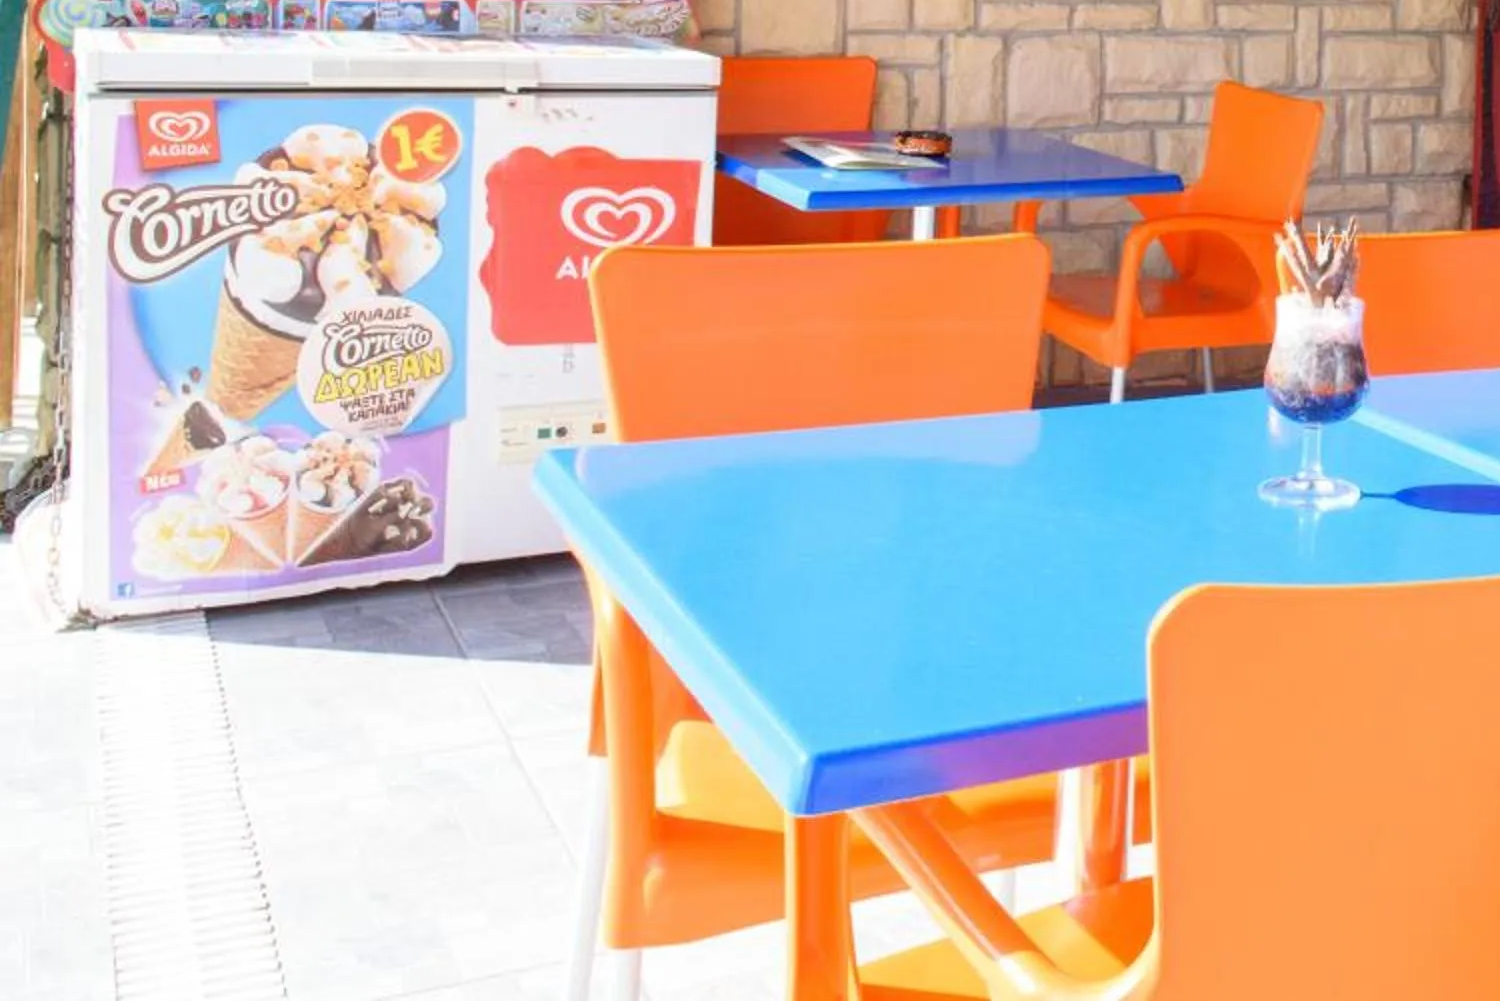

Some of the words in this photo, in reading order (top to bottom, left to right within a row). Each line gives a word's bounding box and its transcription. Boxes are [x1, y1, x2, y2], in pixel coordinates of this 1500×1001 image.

[147, 143, 209, 157] ALGIDA
[391, 124, 447, 172] 1€
[103, 180, 297, 283] Cornetto
[341, 306, 412, 324] ΧΙΛΙΑΔΕΣ
[322, 323, 432, 372] Cornetto
[314, 346, 444, 403] ΔΩΡΕΑΝ
